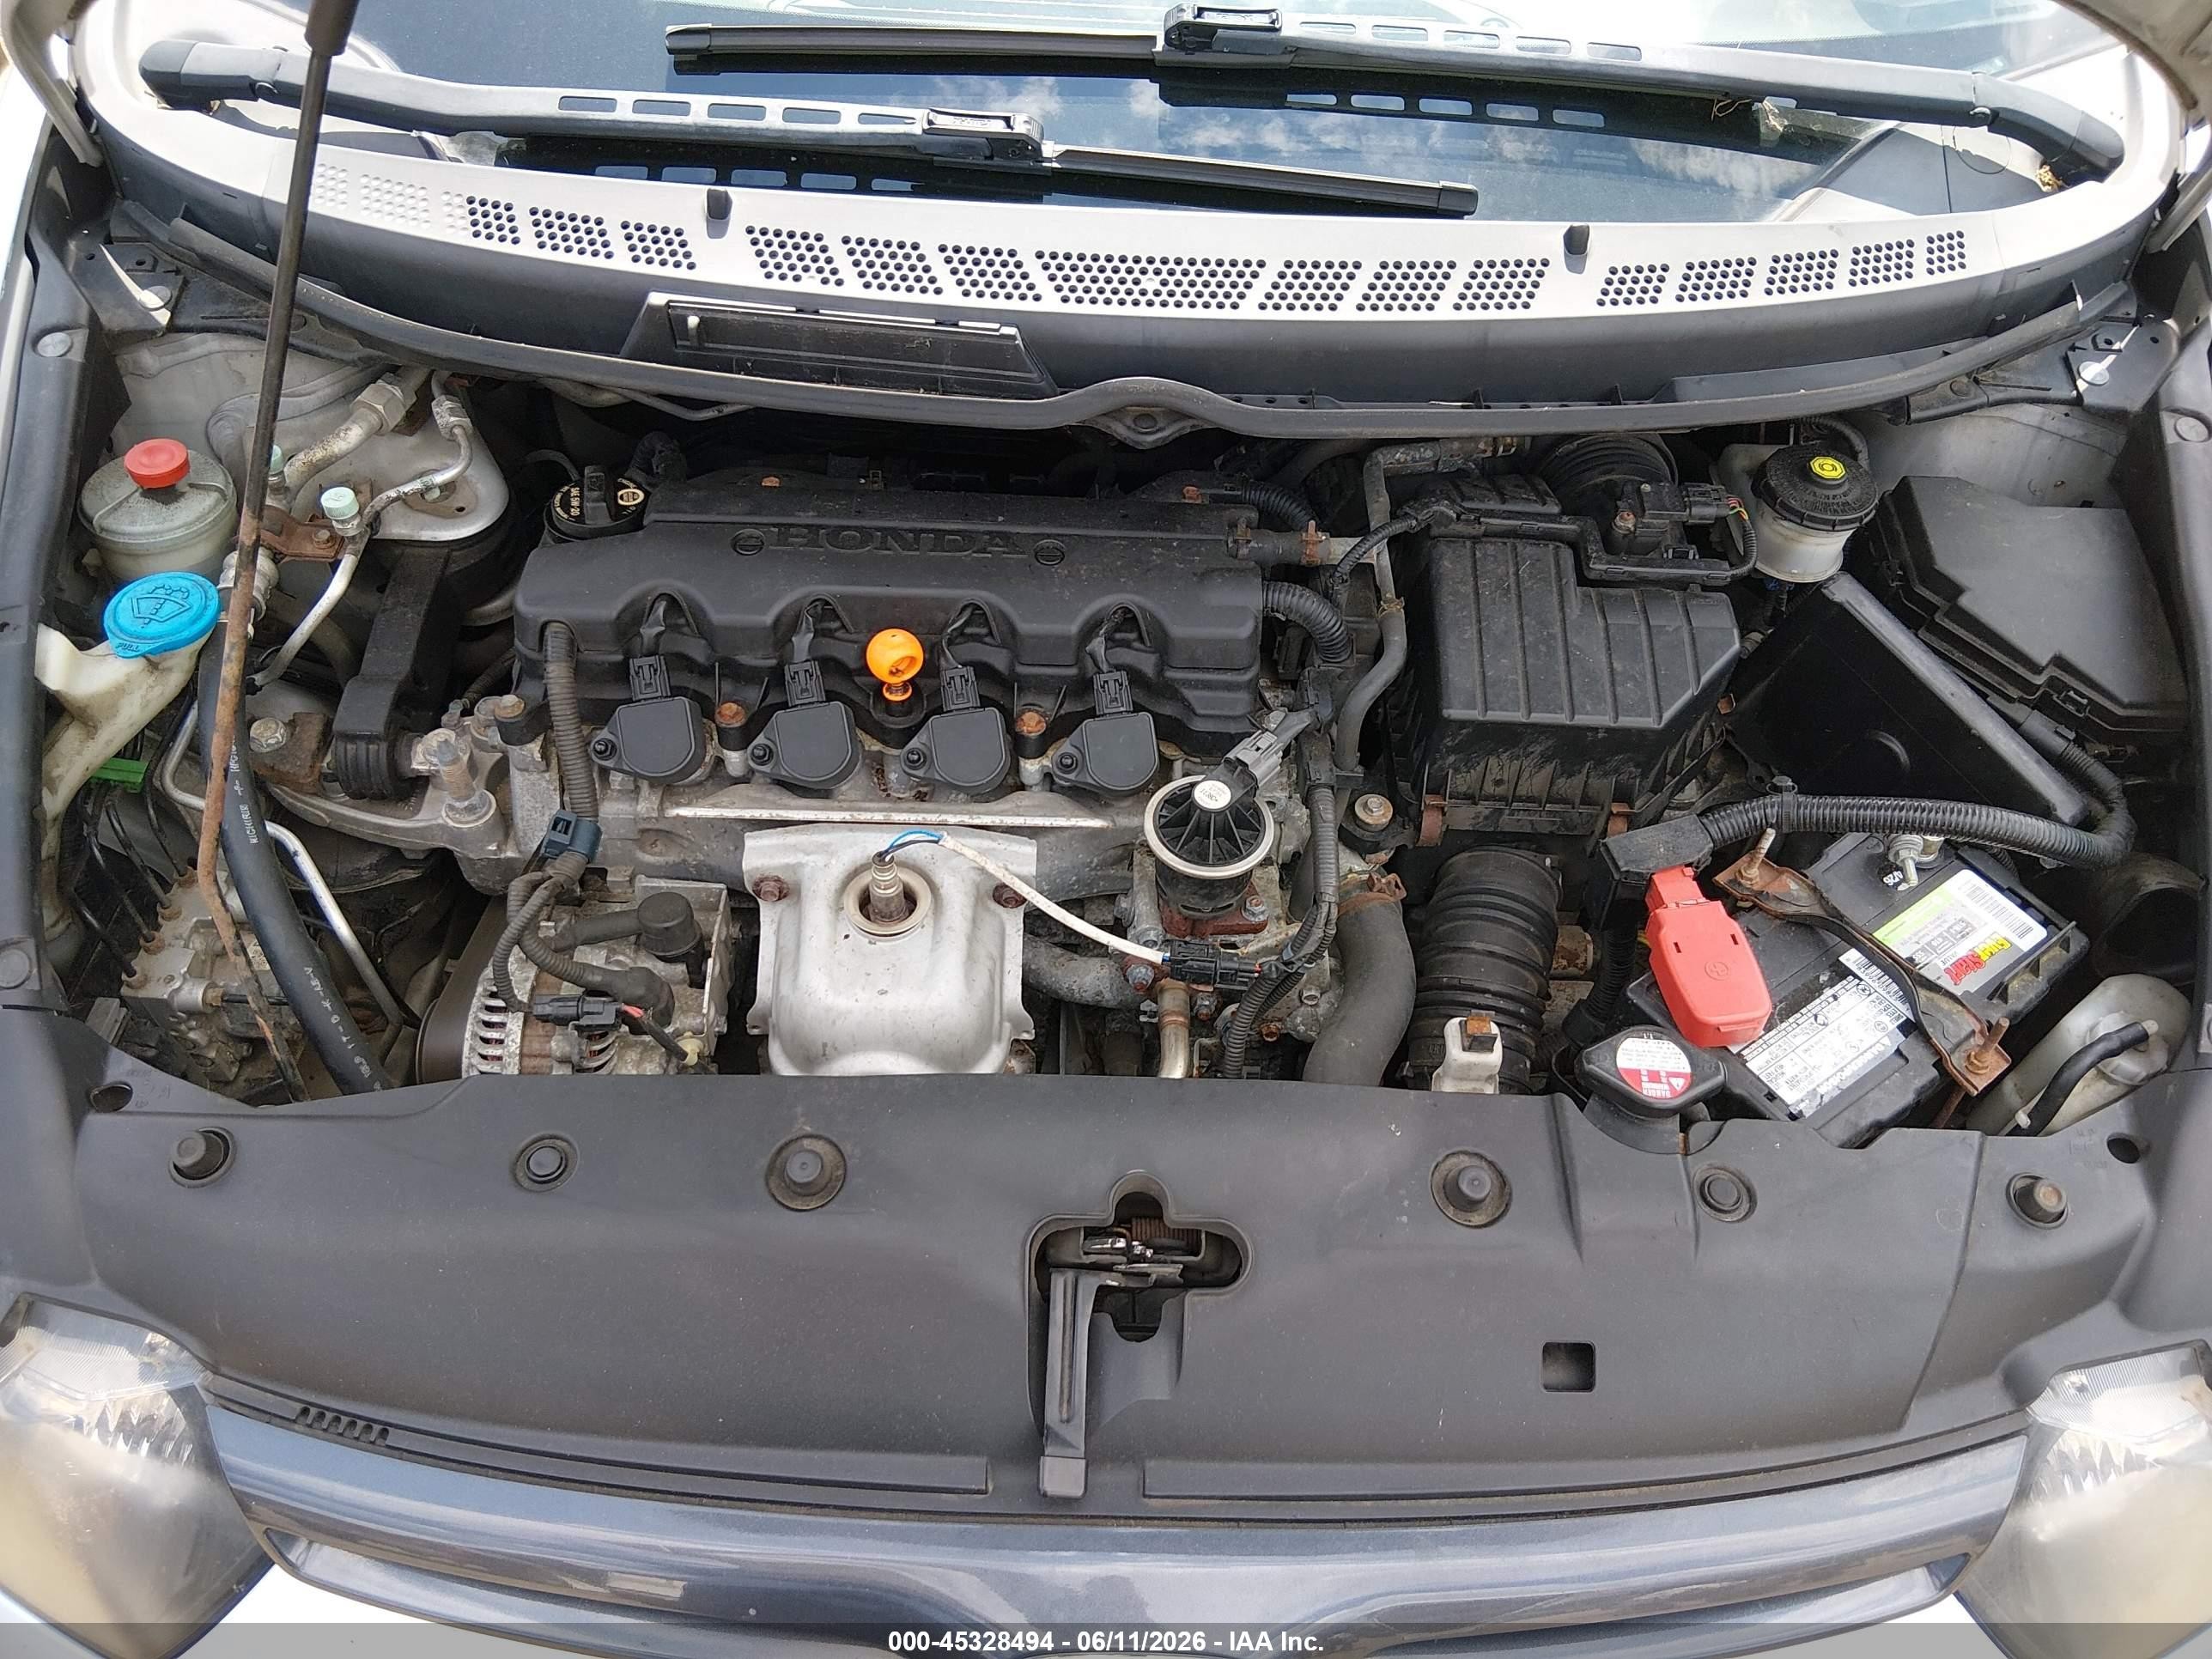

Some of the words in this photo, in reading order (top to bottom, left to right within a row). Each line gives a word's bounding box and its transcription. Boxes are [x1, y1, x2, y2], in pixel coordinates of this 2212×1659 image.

[769, 526, 1030, 559] HONDA
[115, 641, 139, 652] PULL
[1881, 868, 1904, 886] 4/26
[1939, 949, 1959, 966] VALUE
[1943, 936, 2012, 986] EverStart
